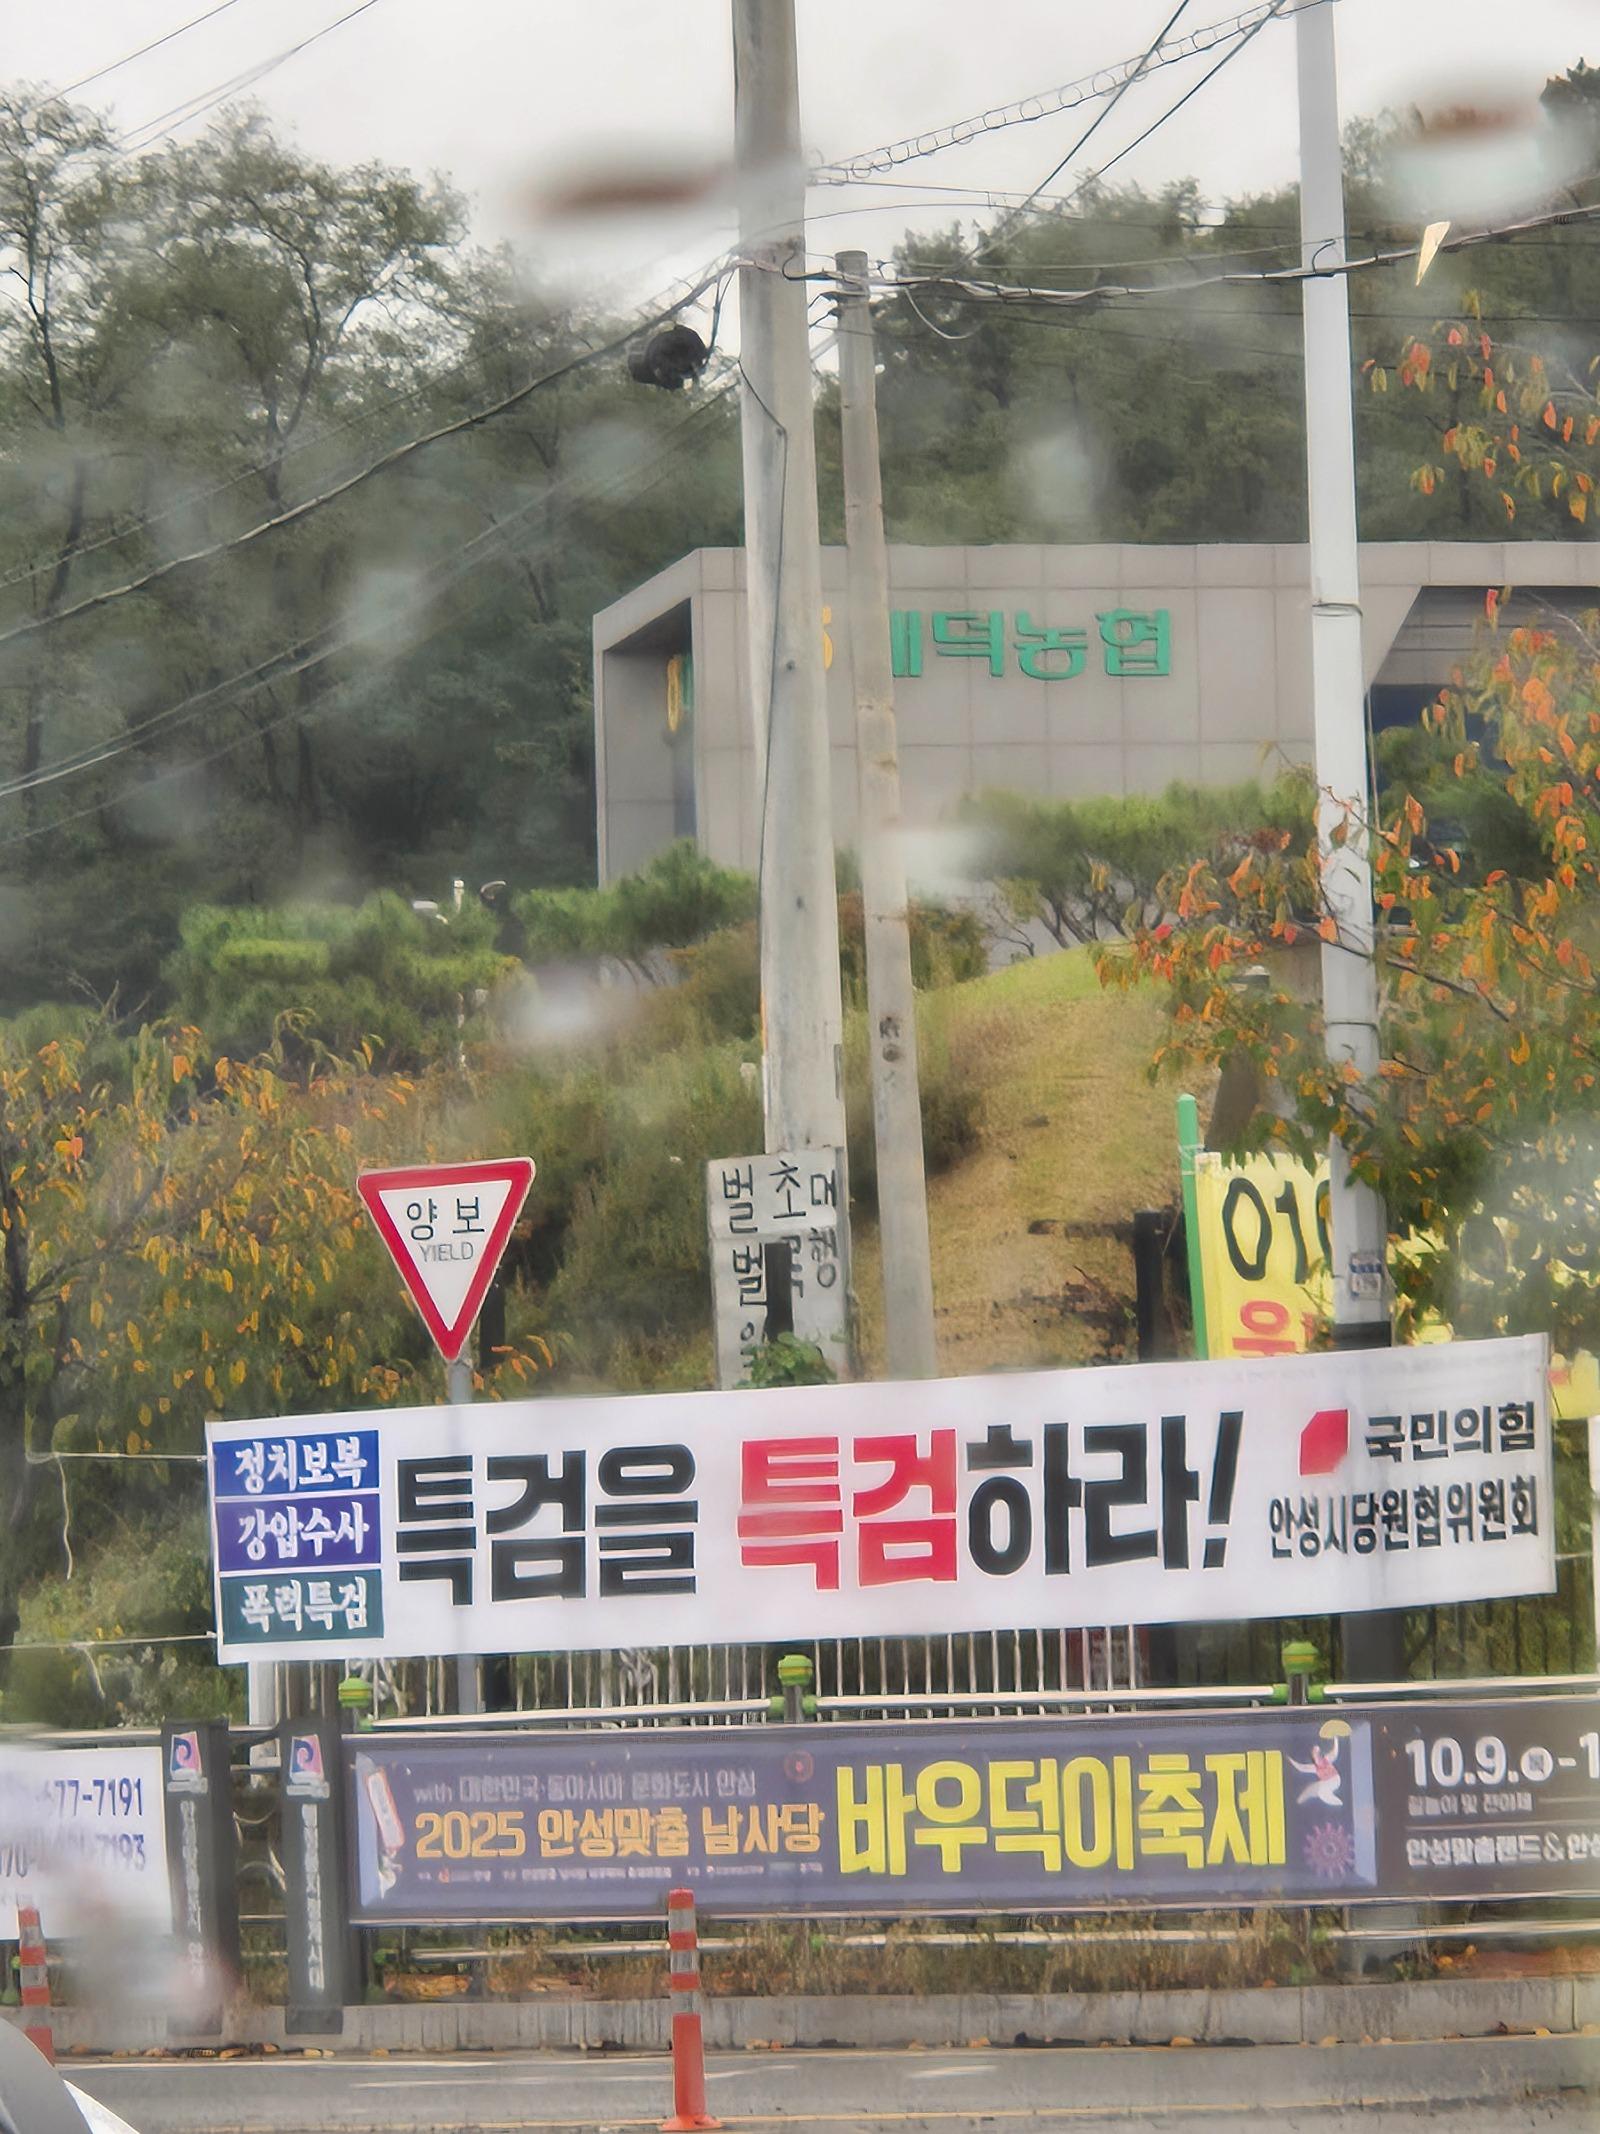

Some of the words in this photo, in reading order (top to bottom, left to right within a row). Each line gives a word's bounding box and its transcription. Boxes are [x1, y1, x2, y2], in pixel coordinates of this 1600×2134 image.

[406, 1196, 486, 1241] 양보
[419, 1242, 475, 1262] YIELD
[1365, 1401, 1536, 1463] 국민의힘
[234, 1436, 370, 1494] 정치보복
[237, 1501, 373, 1561] 강압수사
[396, 1443, 699, 1607] 특검을
[737, 1410, 1244, 1592] 특검하라!
[240, 1575, 369, 1633] 폭력특검
[415, 1810, 527, 1858] 2025
[537, 1807, 691, 1857] 안성맞춤
[702, 1802, 826, 1856] 남사당
[836, 1749, 1287, 1876] 바우덕이축제
